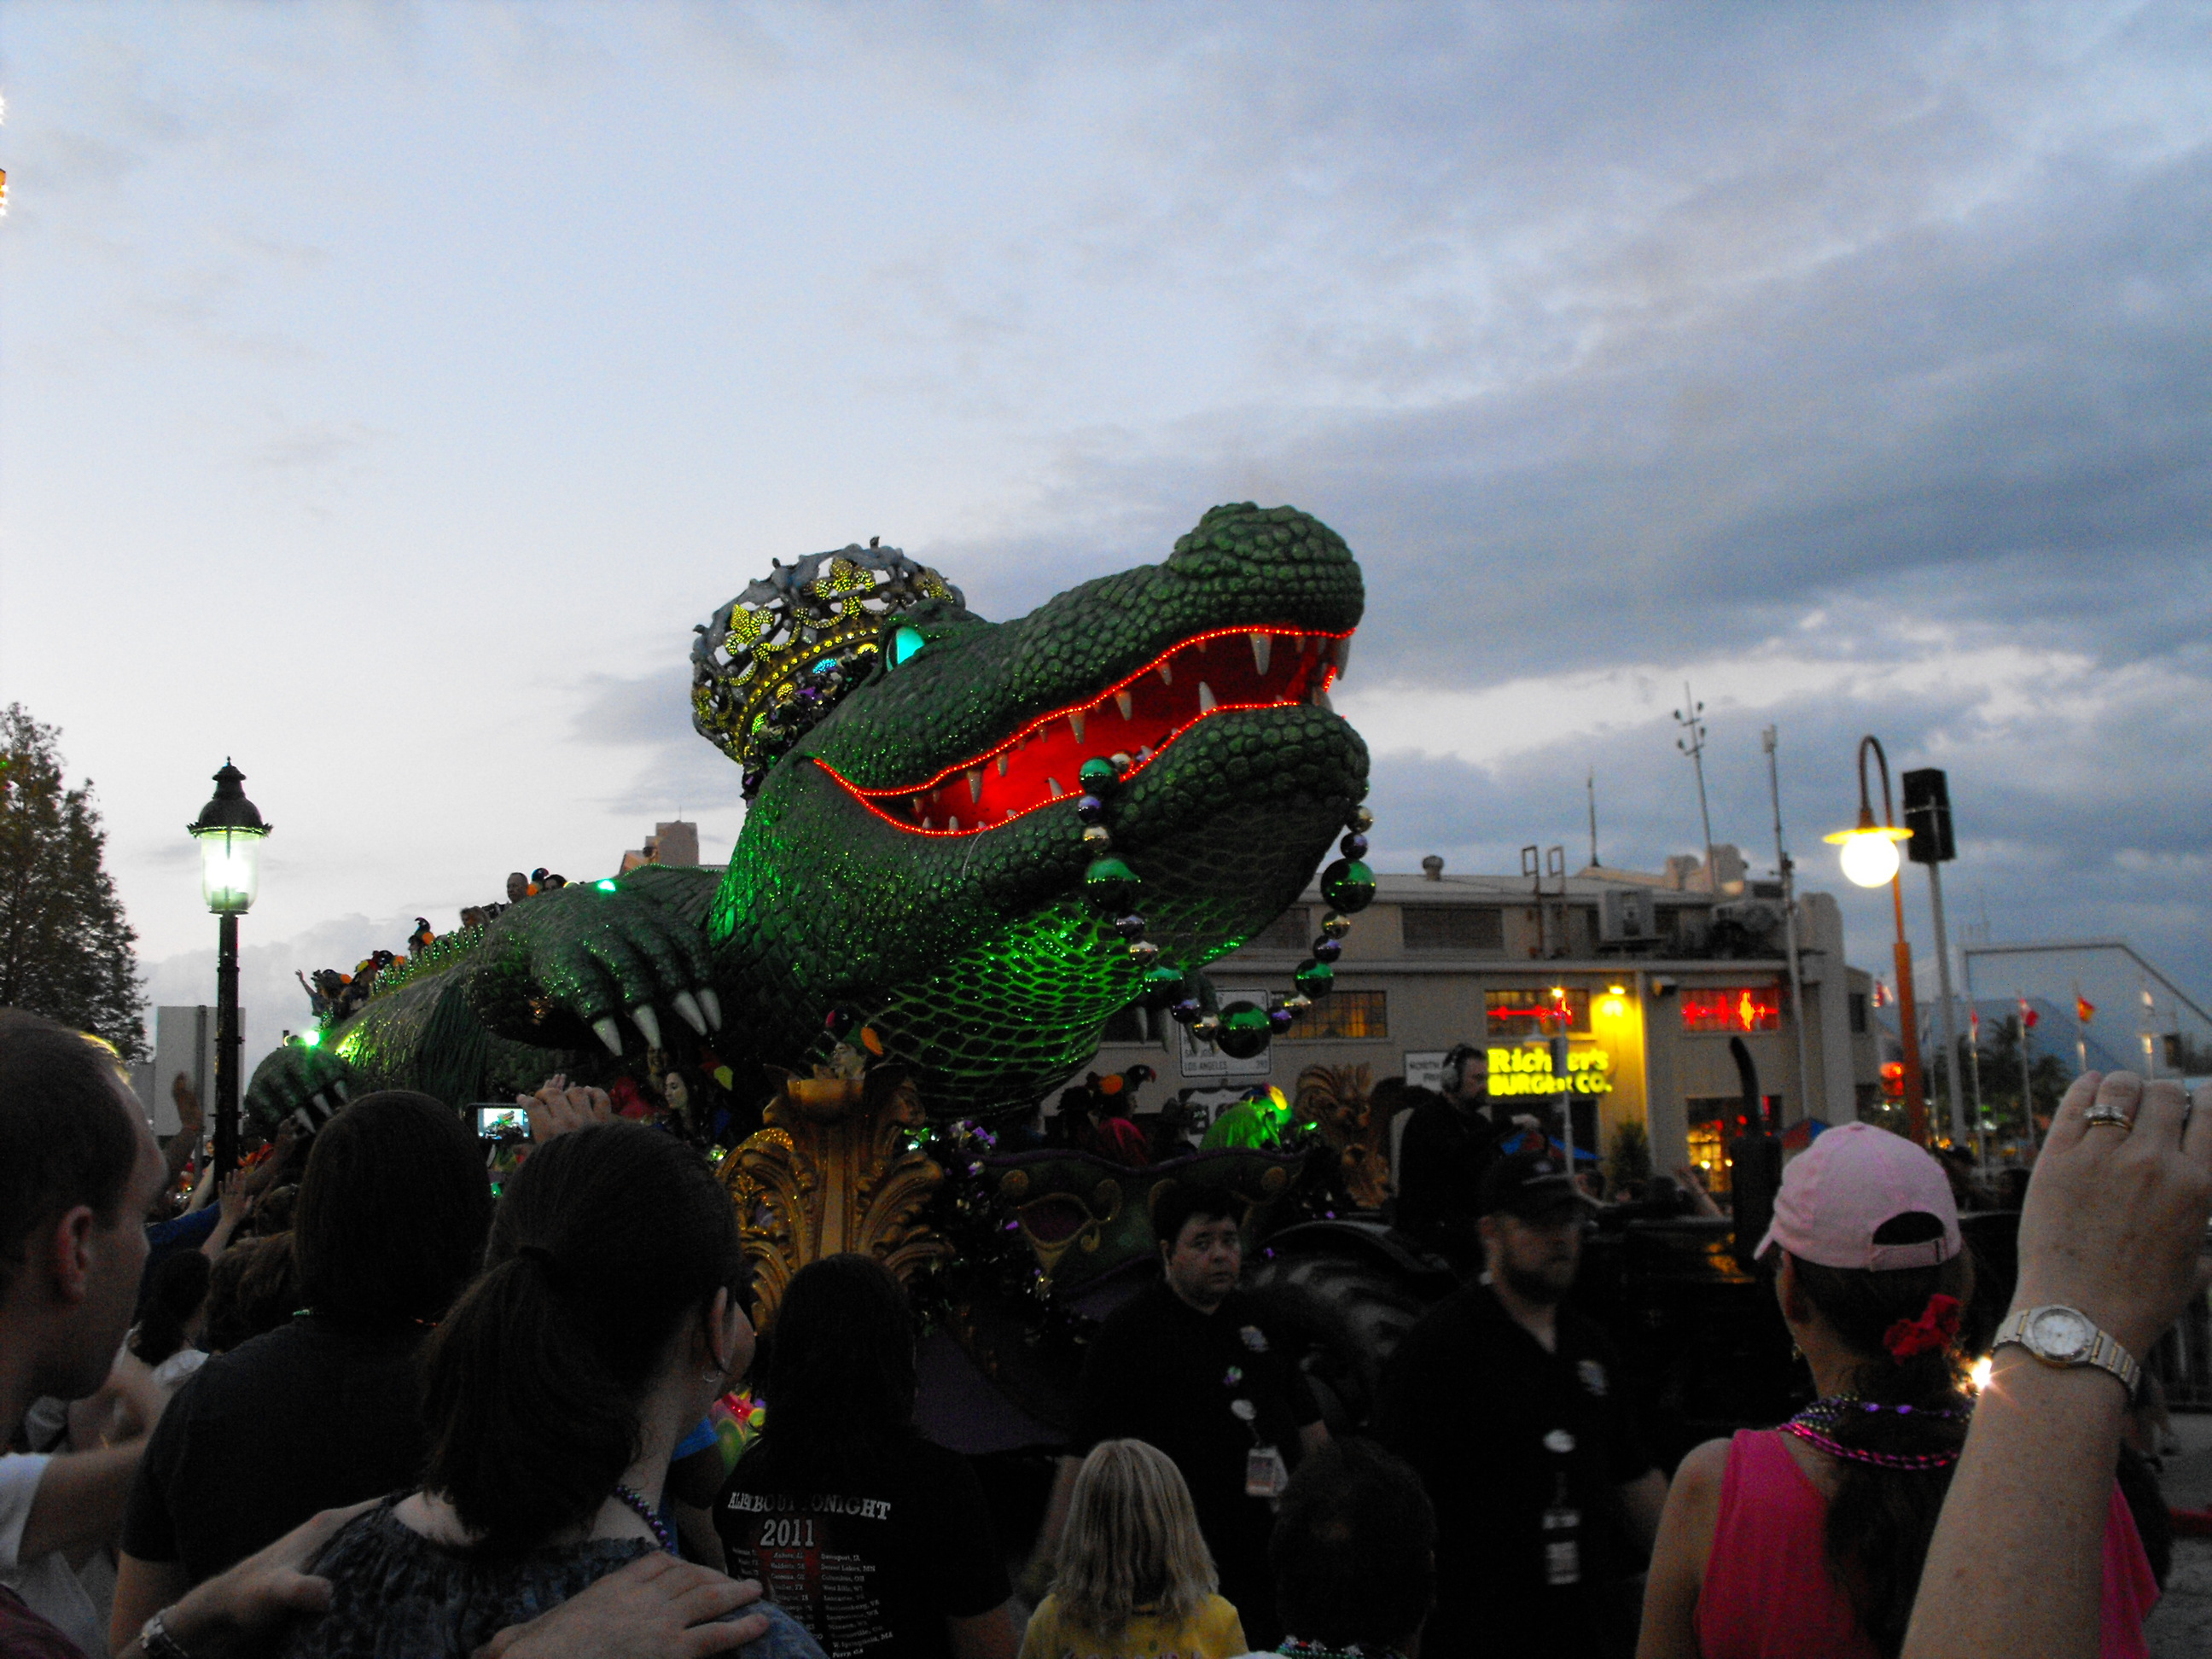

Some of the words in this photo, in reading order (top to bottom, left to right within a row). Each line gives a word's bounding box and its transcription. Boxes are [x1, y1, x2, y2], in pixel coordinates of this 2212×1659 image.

[1487, 1047, 1610, 1073] Richer's
[1575, 1071, 1612, 1094] CO.
[760, 1519, 815, 1547] 2011
